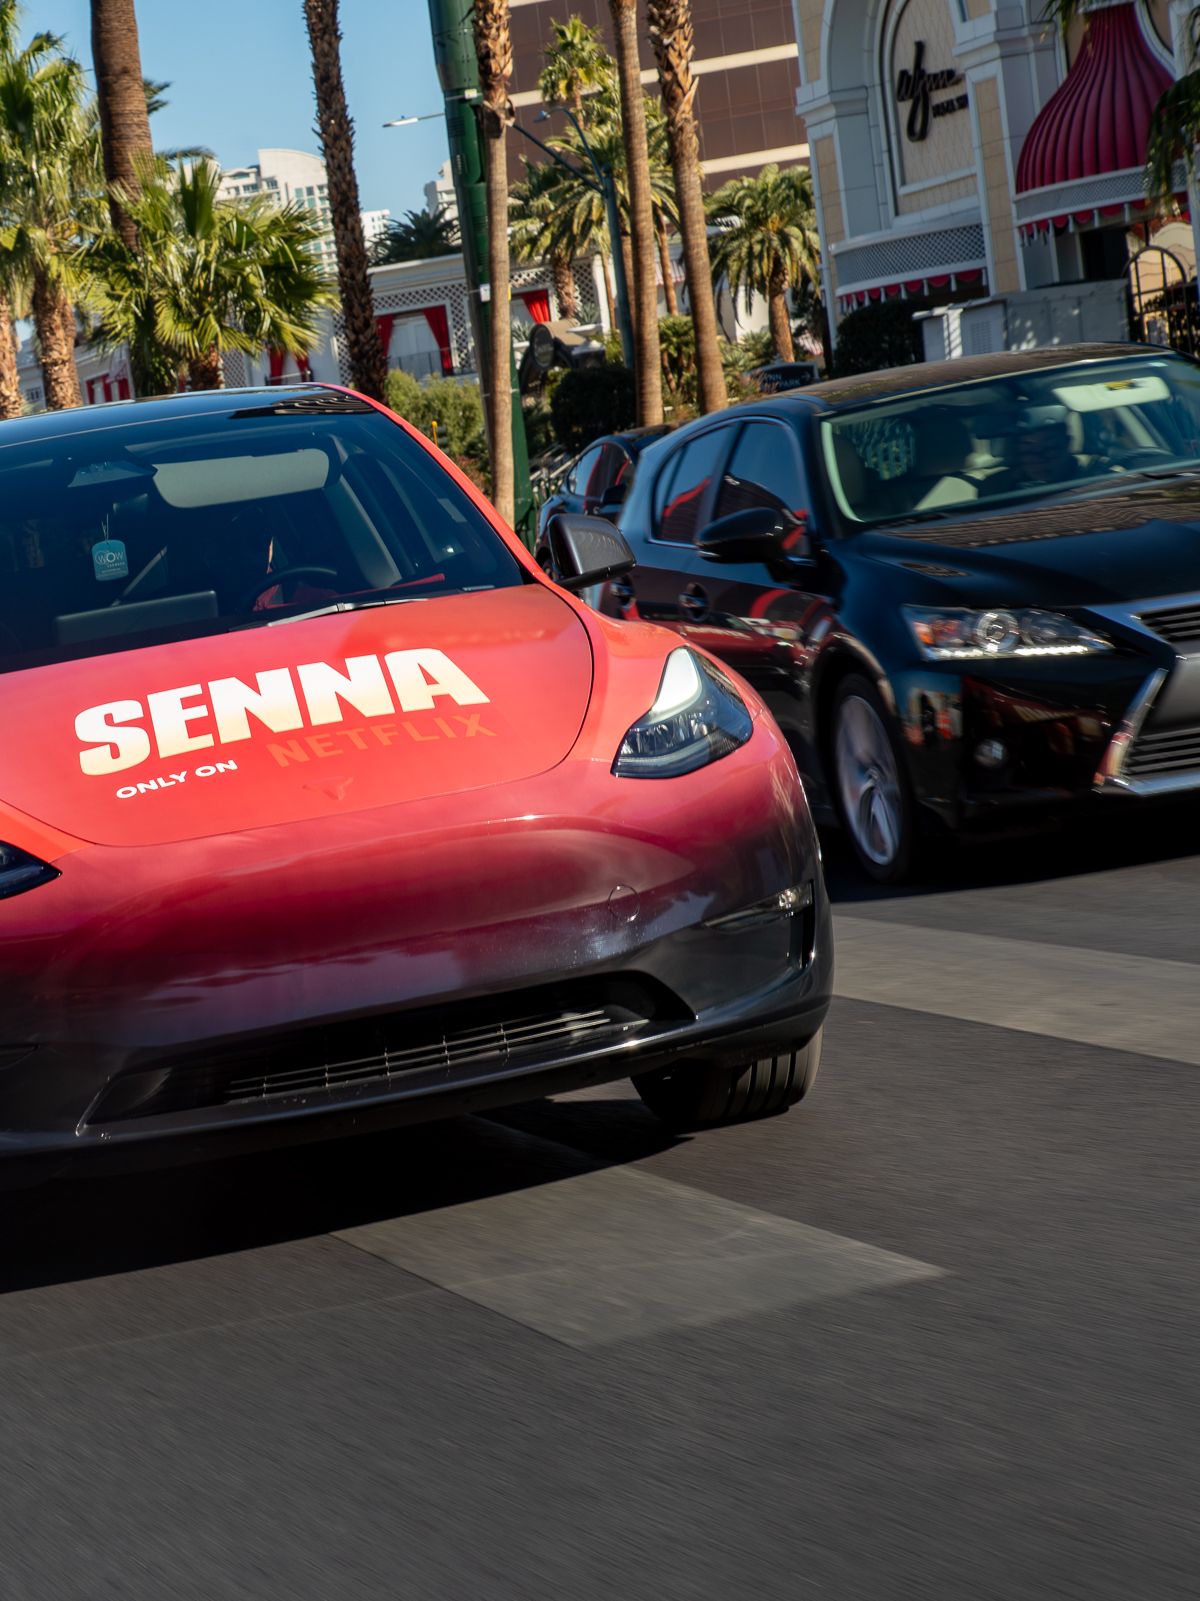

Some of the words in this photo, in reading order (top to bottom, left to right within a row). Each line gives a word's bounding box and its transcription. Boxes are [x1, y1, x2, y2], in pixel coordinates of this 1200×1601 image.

[97, 551, 124, 565] WOW
[74, 648, 490, 776] SENNA
[116, 771, 188, 799] ONLY
[195, 760, 238, 777] ON
[266, 713, 497, 767] NETFLIX
